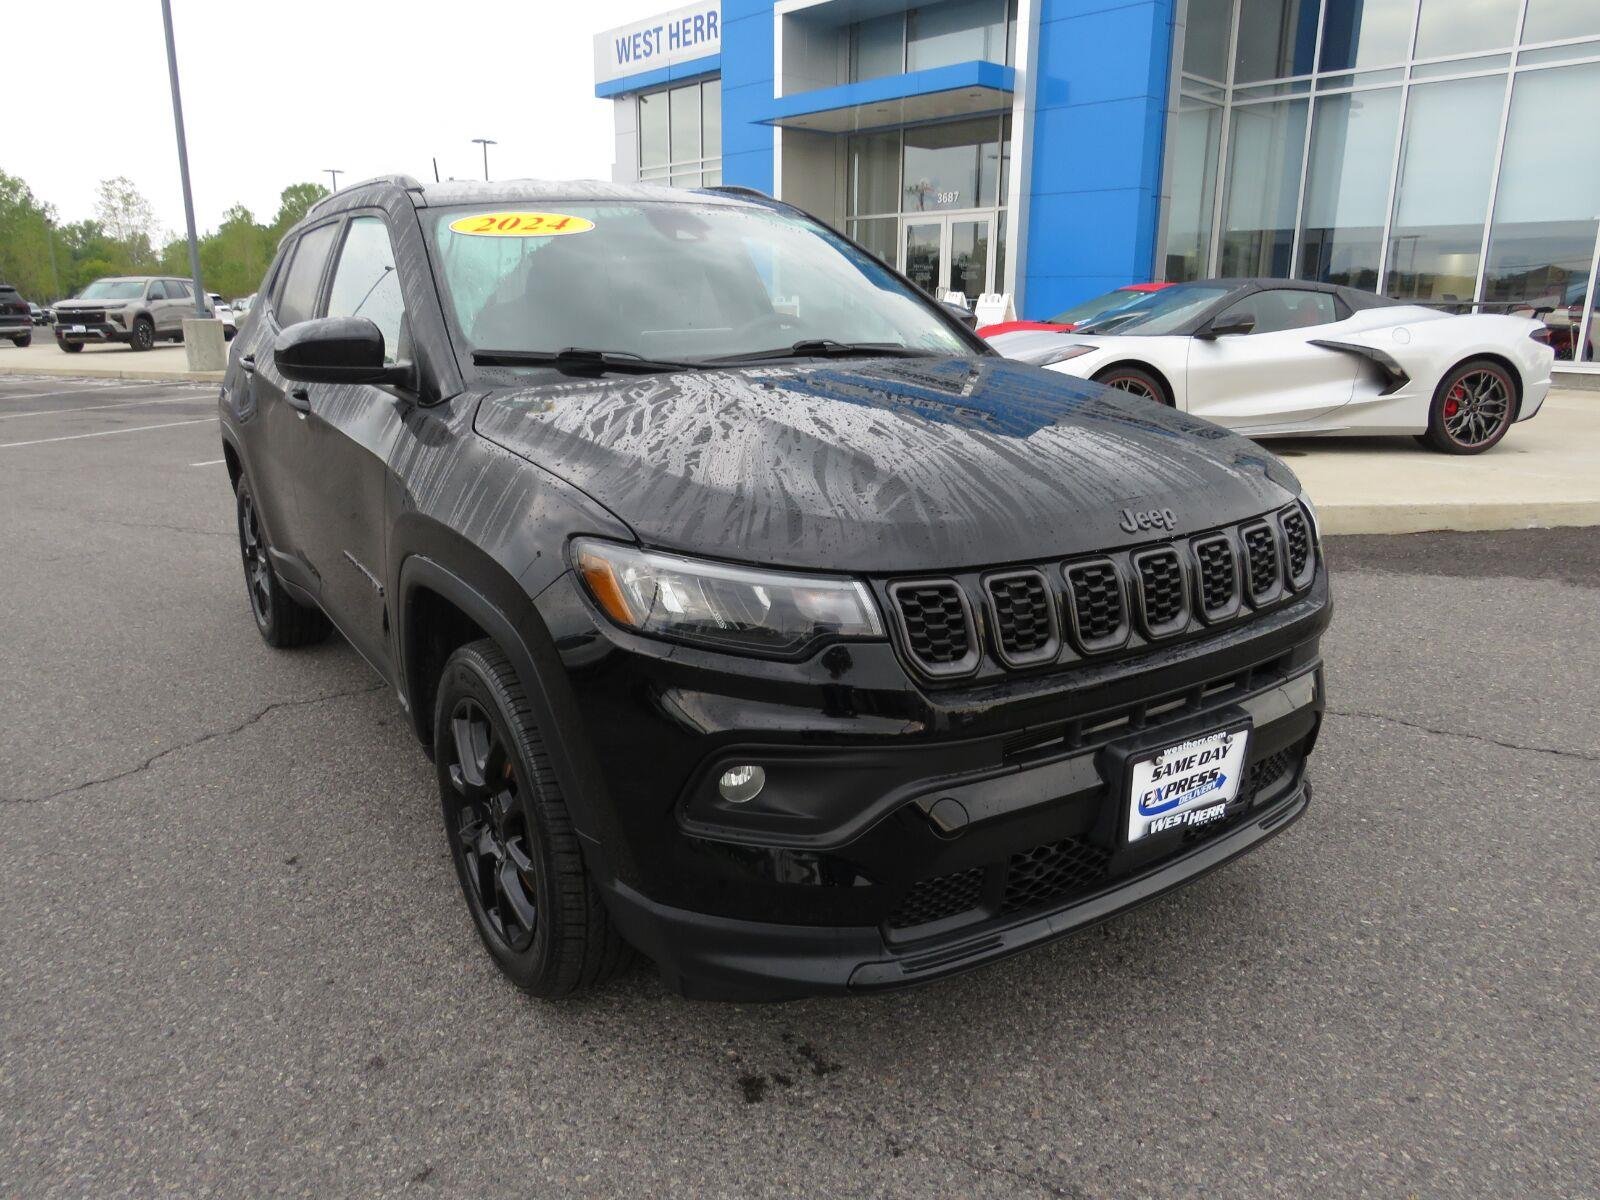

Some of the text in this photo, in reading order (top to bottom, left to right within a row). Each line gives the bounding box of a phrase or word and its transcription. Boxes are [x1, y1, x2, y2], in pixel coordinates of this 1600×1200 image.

[615, 10, 718, 65] WEST HERR
[936, 191, 960, 203] 3687
[472, 216, 571, 233] 2024
[1119, 508, 1177, 534] Jeep
[1163, 731, 1227, 756] westherr.com
[1151, 744, 1233, 783] SAME DAY
[1142, 767, 1221, 808] EXPRESS
[1178, 780, 1218, 805] DELIVERY
